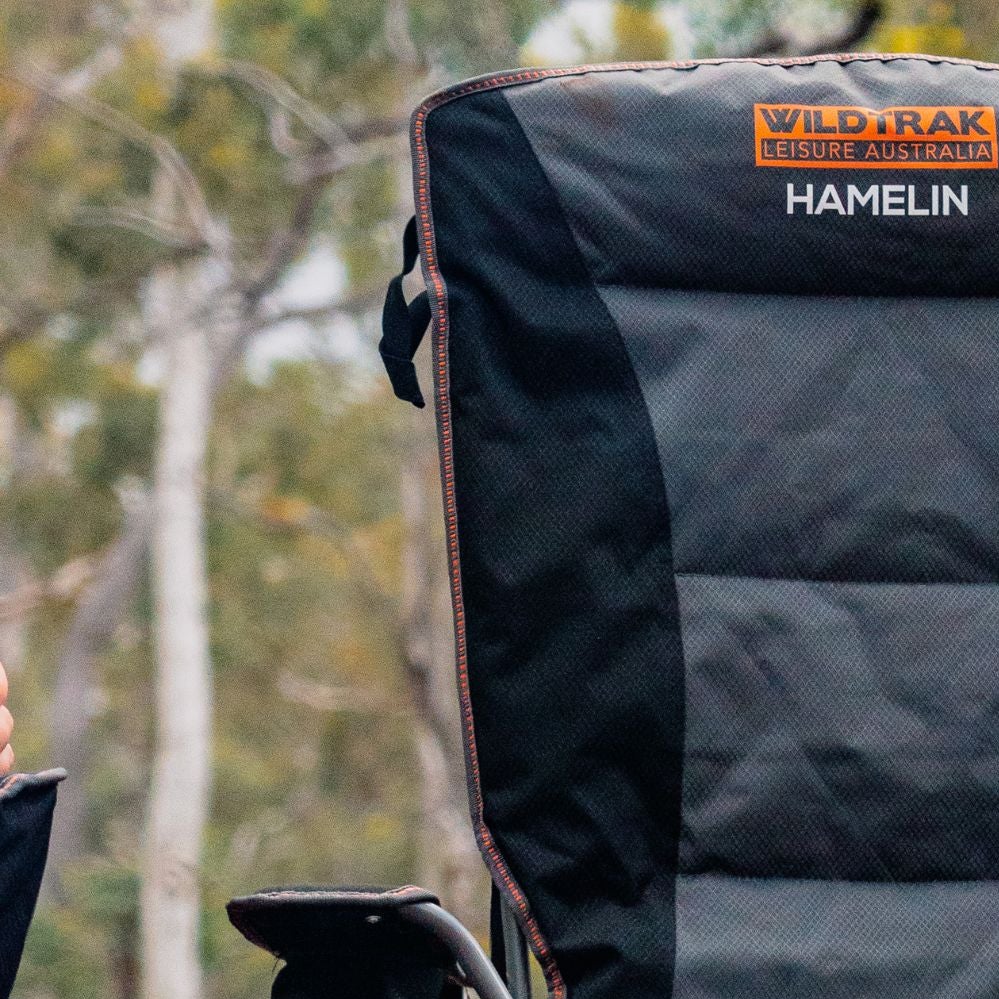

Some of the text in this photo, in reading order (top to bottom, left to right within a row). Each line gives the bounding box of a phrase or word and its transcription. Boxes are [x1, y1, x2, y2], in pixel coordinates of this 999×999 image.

[760, 108, 991, 136] WILDTRAK
[763, 141, 992, 160] LEISURE AUSTRALIA
[786, 183, 969, 216] HAMELIN
